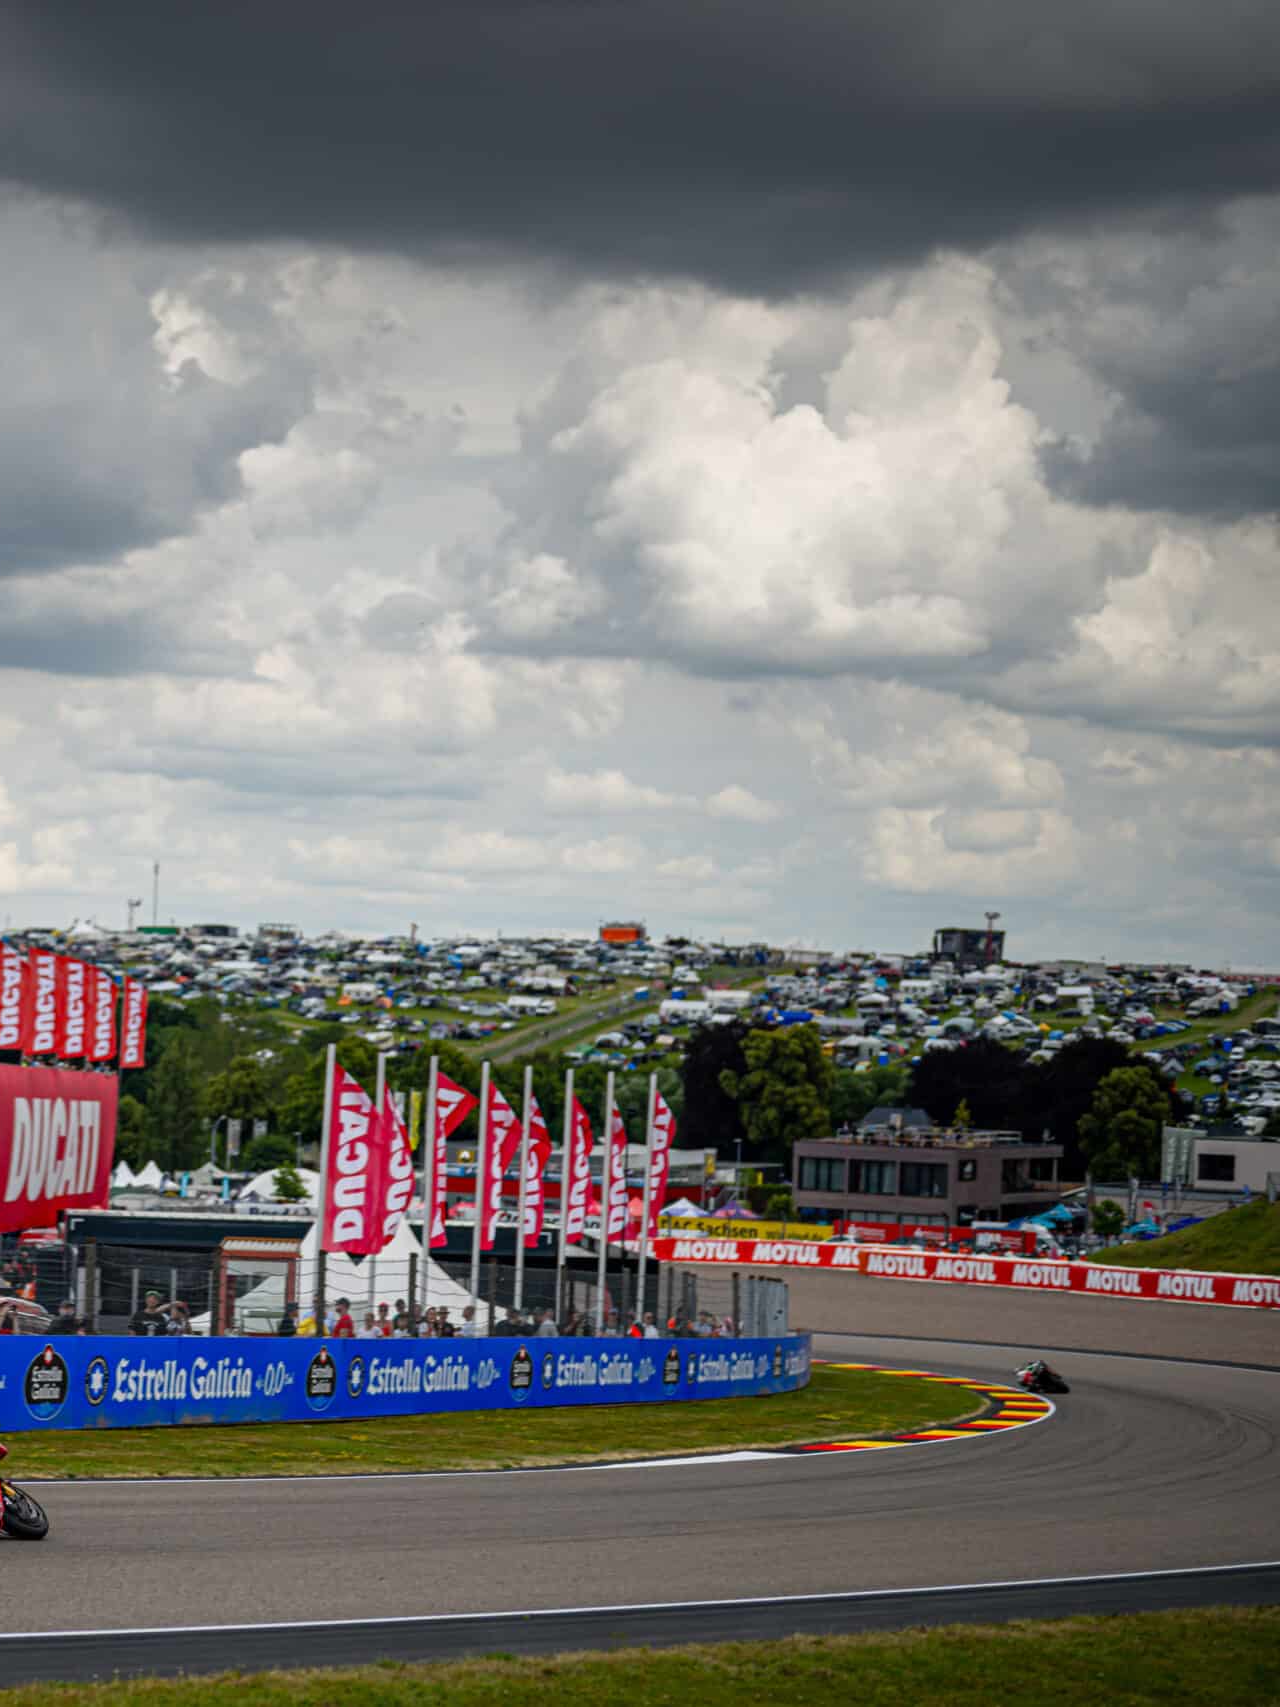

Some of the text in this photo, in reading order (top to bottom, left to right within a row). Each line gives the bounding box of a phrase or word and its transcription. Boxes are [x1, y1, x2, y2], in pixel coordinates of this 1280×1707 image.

[4, 1097, 101, 1202] DUCATI
[673, 1241, 739, 1260] MOTUL
[752, 1243, 820, 1264] MOTUL
[867, 1255, 927, 1276] MOTUL
[933, 1258, 997, 1281] MOTUL
[1012, 1264, 1072, 1287] MOTUL
[1086, 1269, 1142, 1293] MOTUL
[1157, 1274, 1216, 1299] MOTUL
[1232, 1280, 1280, 1303] MOTU
[112, 1358, 188, 1402] Estrella
[190, 1356, 253, 1400] Galicia
[367, 1356, 420, 1395] Estrella
[423, 1355, 469, 1393] Galicia
